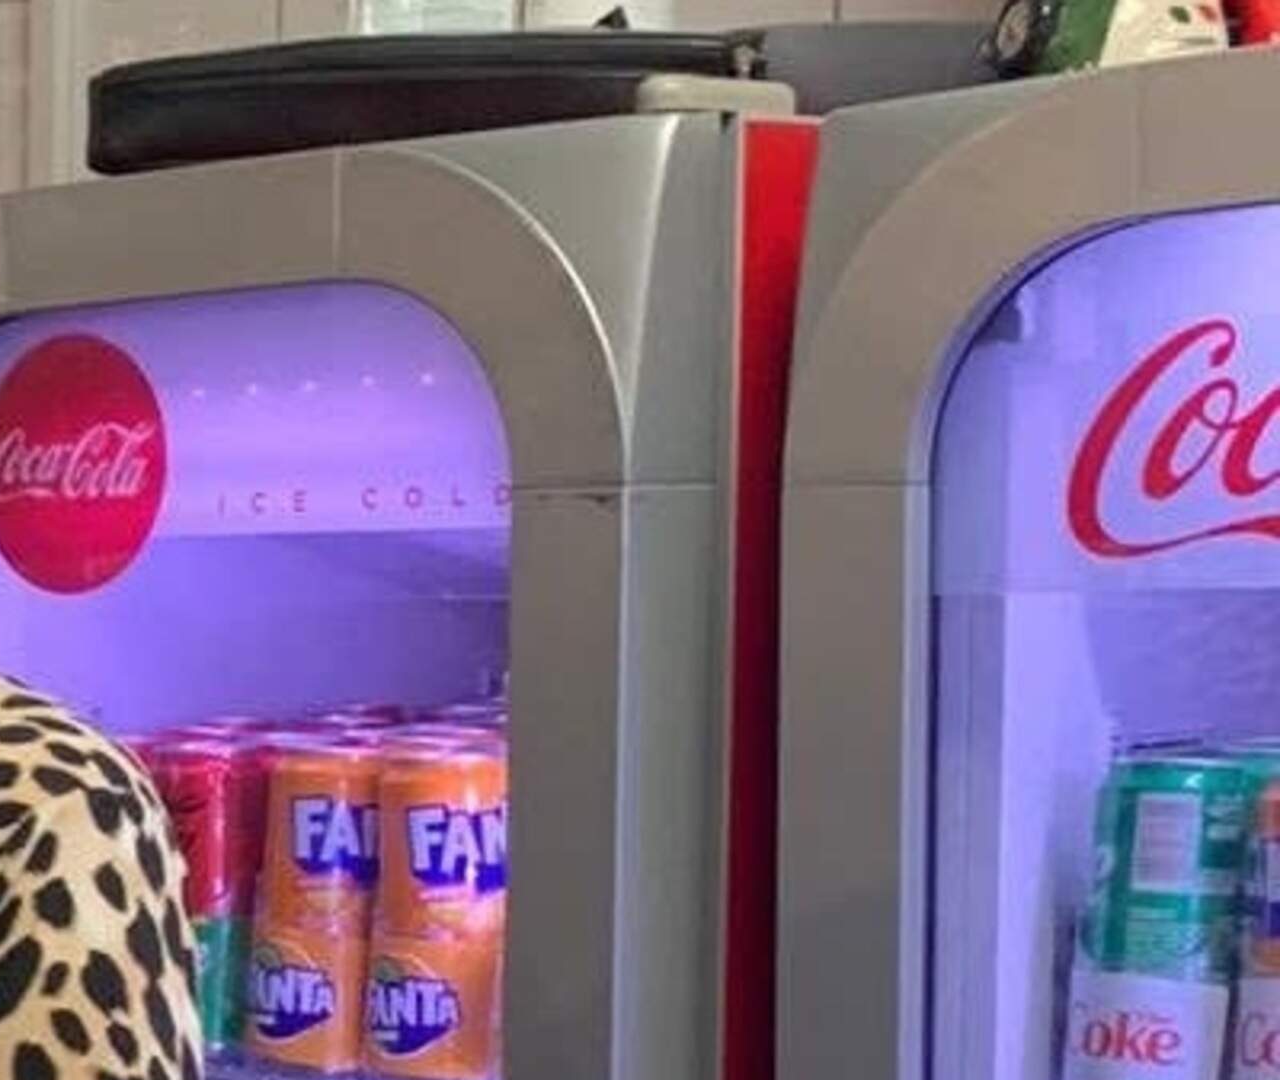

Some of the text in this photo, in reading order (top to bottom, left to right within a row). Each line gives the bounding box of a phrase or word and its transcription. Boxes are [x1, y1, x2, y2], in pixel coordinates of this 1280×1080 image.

[218, 484, 511, 514] ICE COLD
[1082, 1012, 1182, 1066] oke
